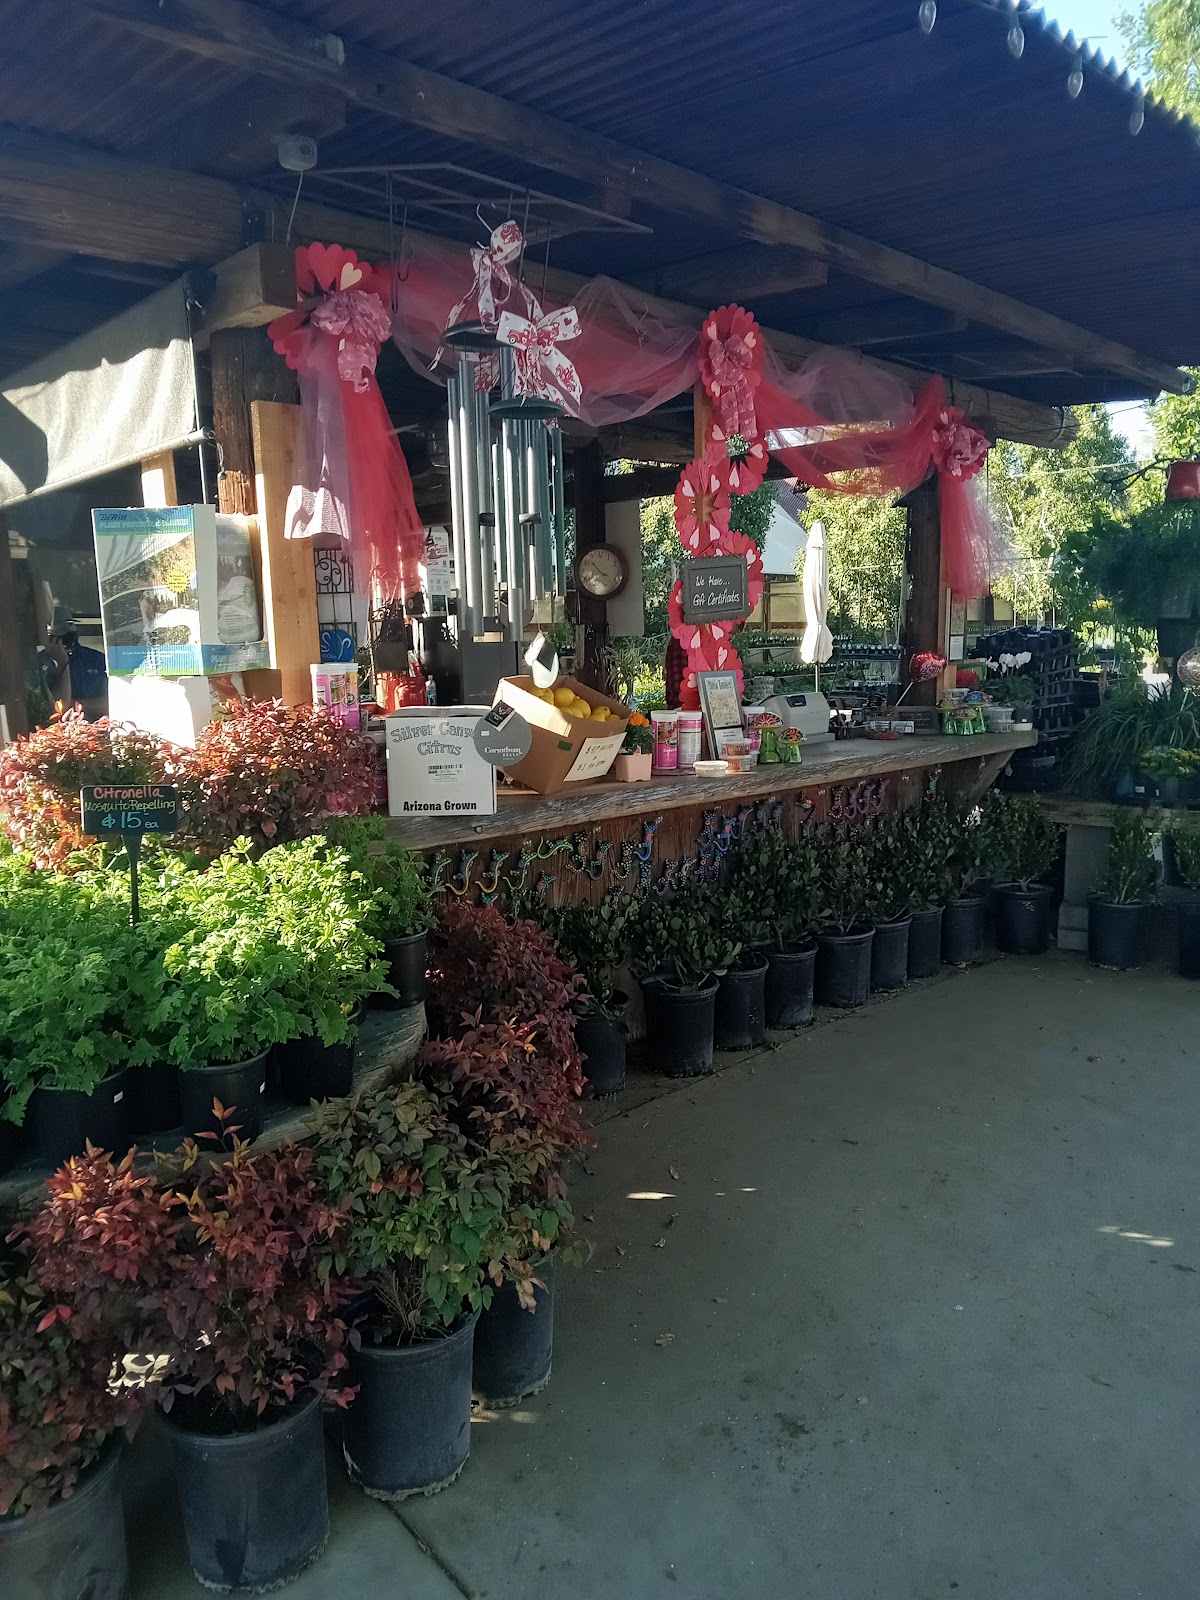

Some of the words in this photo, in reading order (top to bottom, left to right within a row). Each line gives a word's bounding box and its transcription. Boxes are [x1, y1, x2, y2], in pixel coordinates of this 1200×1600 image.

[695, 575, 705, 587] We
[692, 592, 706, 607] Gift
[707, 587, 740, 606] Certificates
[390, 724, 436, 743] Silver
[416, 739, 462, 756] Citrus
[93, 785, 164, 799] Citronella
[84, 800, 130, 813] Mosquito
[129, 798, 176, 814] Repelling
[403, 801, 441, 812] Arizona
[444, 800, 477, 811] Grown
[144, 821, 159, 829] ea
